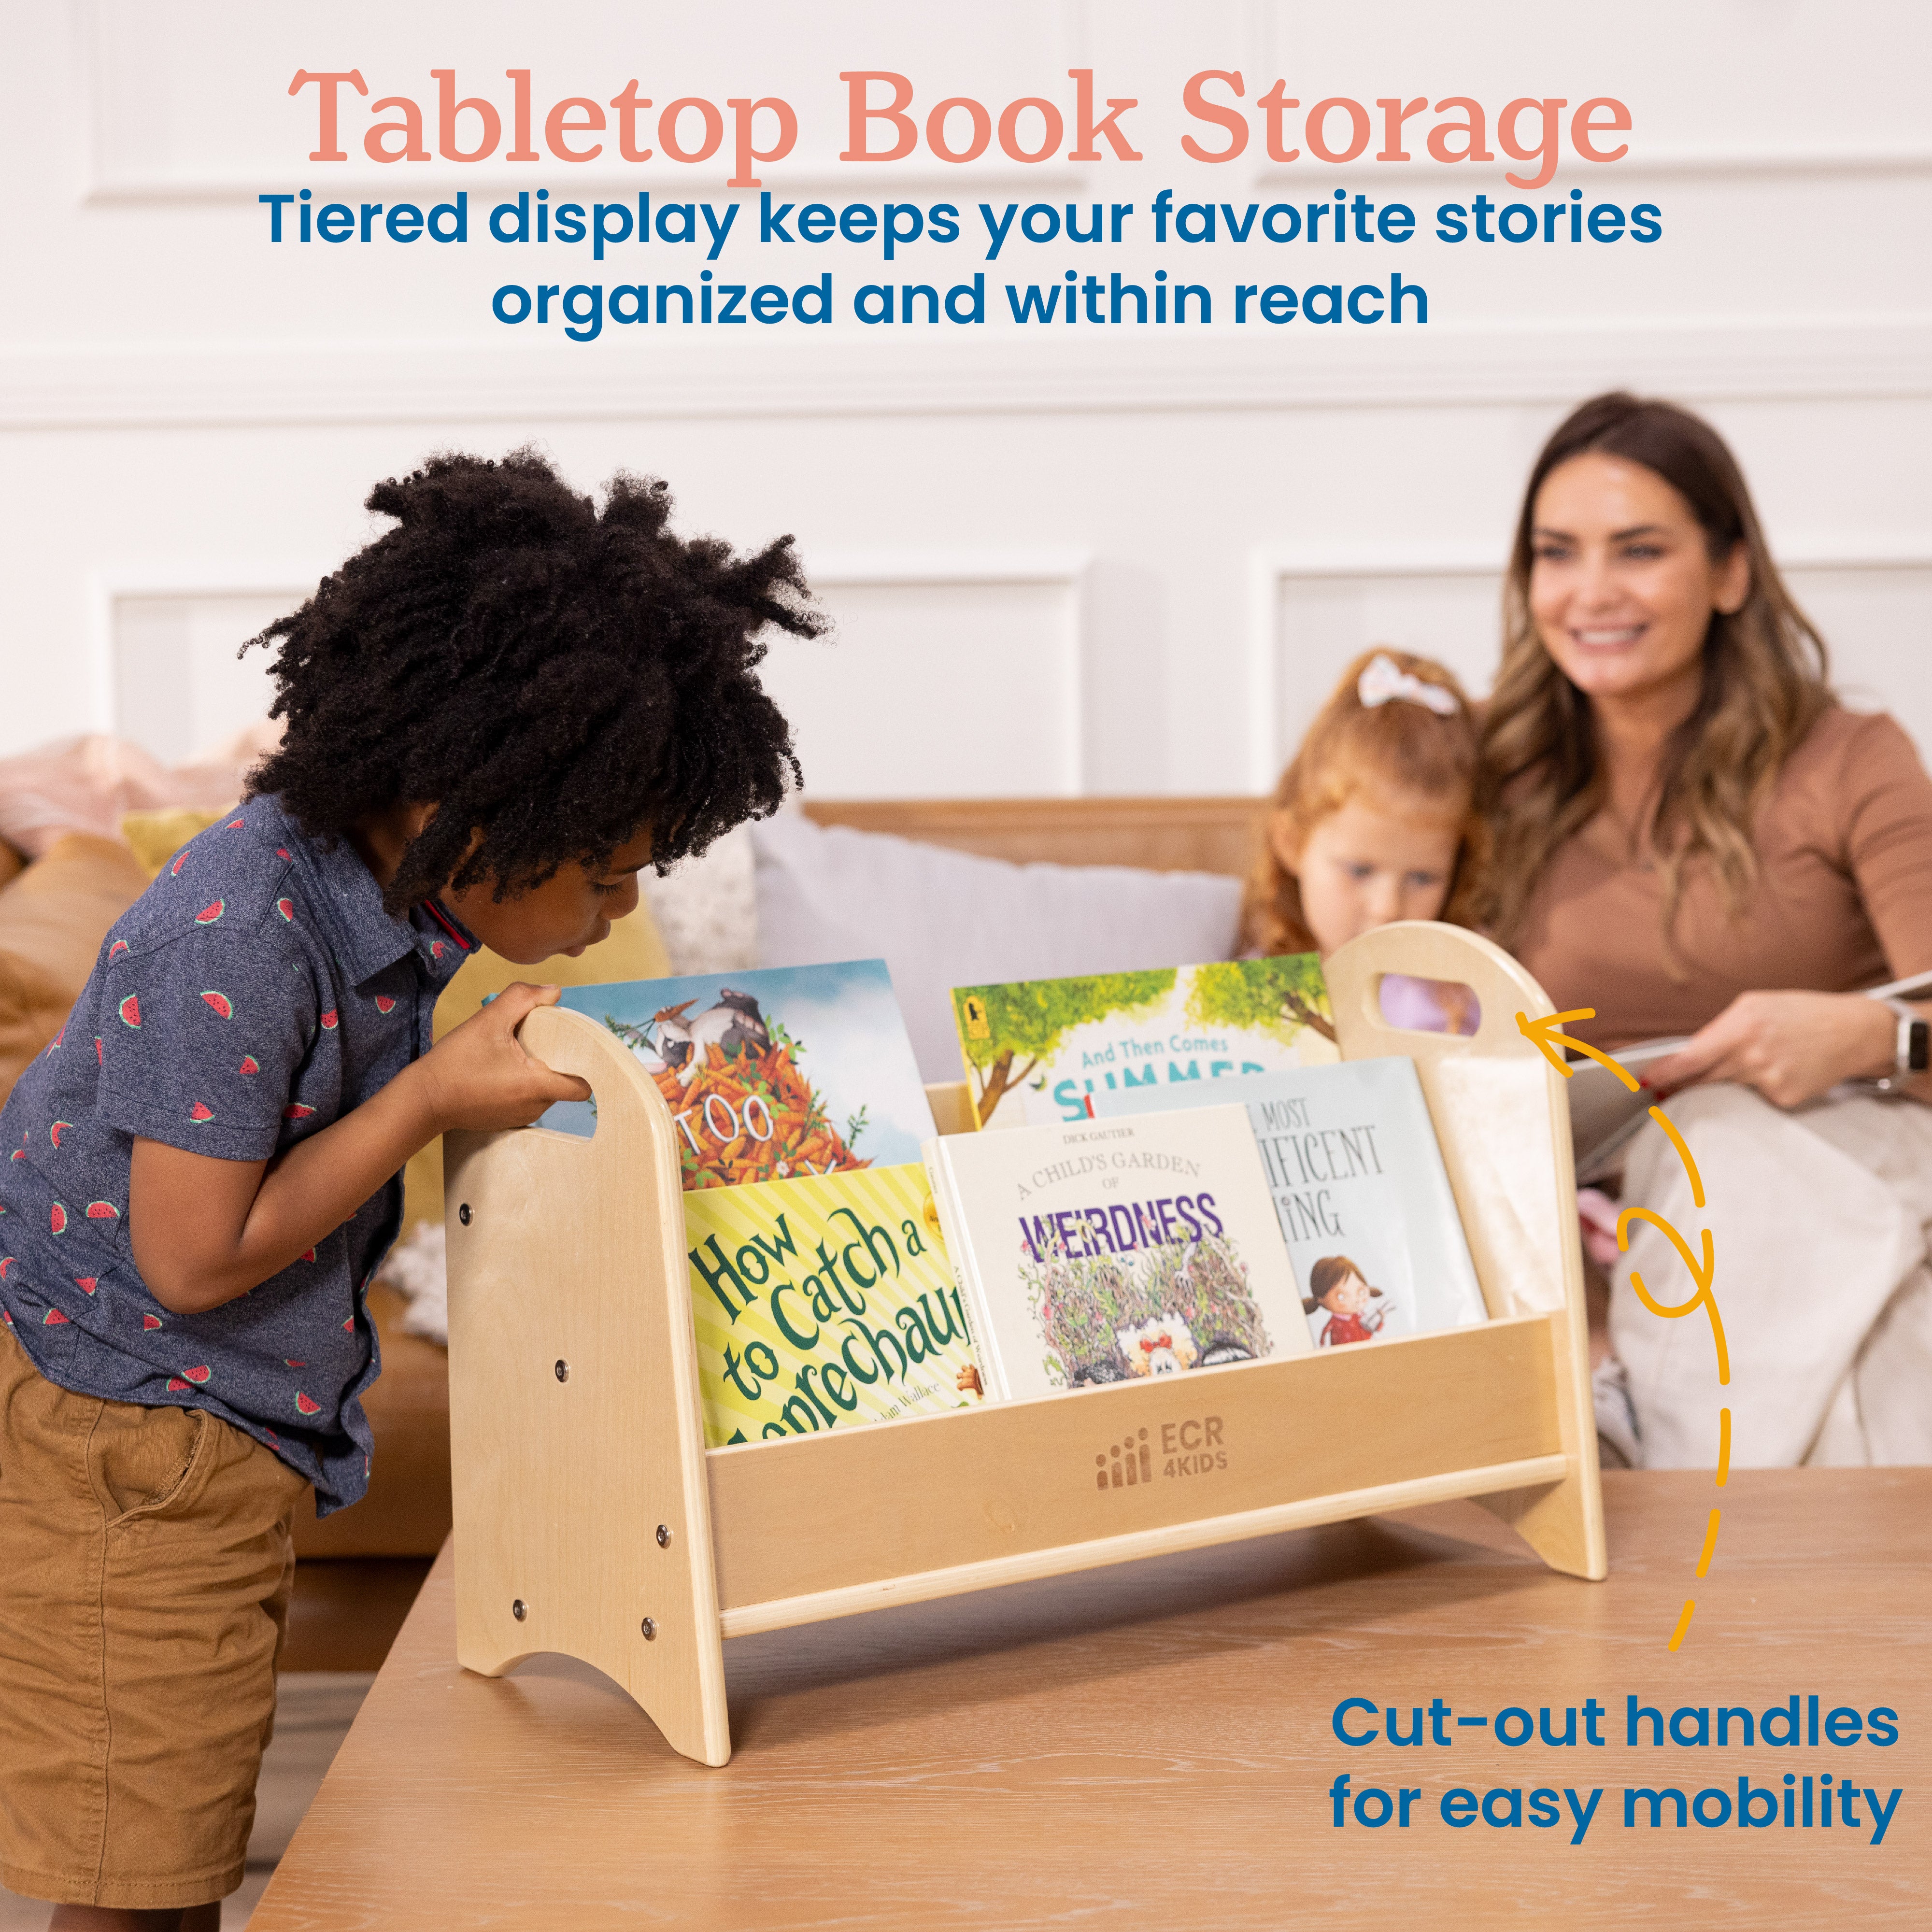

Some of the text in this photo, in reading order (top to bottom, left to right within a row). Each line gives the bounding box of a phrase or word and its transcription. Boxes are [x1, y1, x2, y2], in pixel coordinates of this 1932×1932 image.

[1082, 1034, 1228, 1068] And Then Comes
[674, 1094, 773, 1155] TOO
[1261, 1097, 1310, 1131] MOST
[1063, 1128, 1135, 1144] DICK GAUTIER
[1258, 1124, 1382, 1187] IFICENT
[1017, 1151, 1201, 1200] A CHILD'S GARDEN
[1102, 1177, 1120, 1189] OF
[1019, 1193, 1224, 1264] WEIRDNESS
[688, 1213, 797, 1325] How
[723, 1208, 927, 1401] to Catch a
[874, 1382, 940, 1421] dam Wallace
[1161, 1416, 1224, 1454] ECR
[1163, 1450, 1228, 1478] 4KIDS
